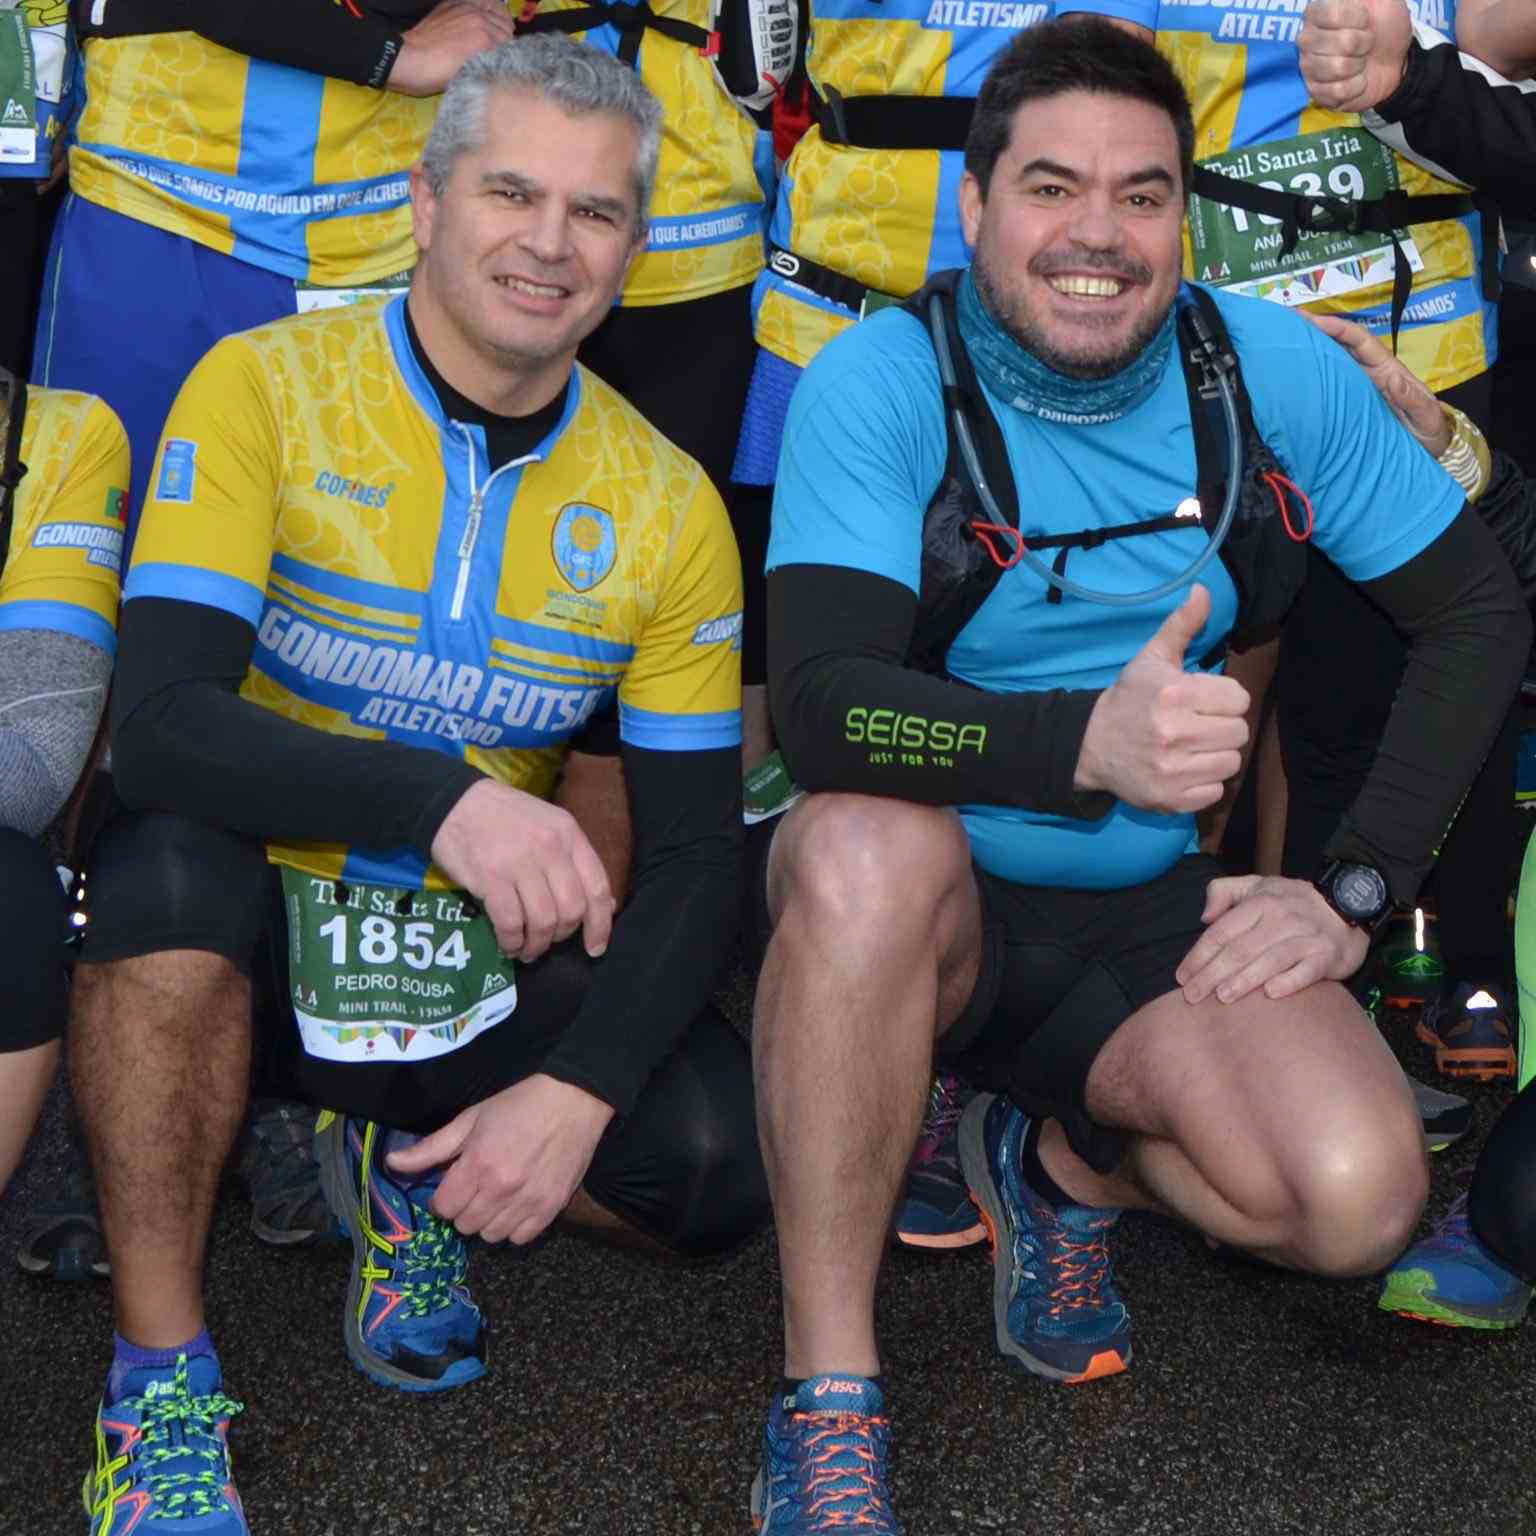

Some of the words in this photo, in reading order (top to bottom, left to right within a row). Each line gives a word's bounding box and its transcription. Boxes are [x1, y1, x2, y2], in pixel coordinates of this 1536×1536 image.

[928, 0, 1048, 28] ATLETISMO
[1205, 153, 1254, 180] Trail
[1257, 144, 1318, 174] Santa
[1321, 134, 1362, 162] Iria
[175, 170, 224, 203] SOMOS
[225, 187, 256, 210] POR
[257, 192, 311, 215] AQUILO
[313, 193, 336, 213] EM
[656, 224, 679, 242] QUE
[1253, 234, 1285, 252] ANA
[33, 523, 122, 550] GONDOMA
[258, 607, 484, 712] GONDOMAR
[359, 696, 504, 747] ATLETISMO
[845, 706, 988, 755] SEISSA
[869, 751, 893, 764] JUST
[901, 753, 924, 766] FOR
[932, 755, 954, 768] YOU
[436, 898, 472, 923] Iri
[319, 914, 472, 973] 1854
[334, 974, 398, 993] PEDRO
[401, 976, 455, 999] SOUSA
[339, 1001, 369, 1015] MINI
[374, 1000, 407, 1016] TRAIL
[830, 1380, 865, 1394] asics
